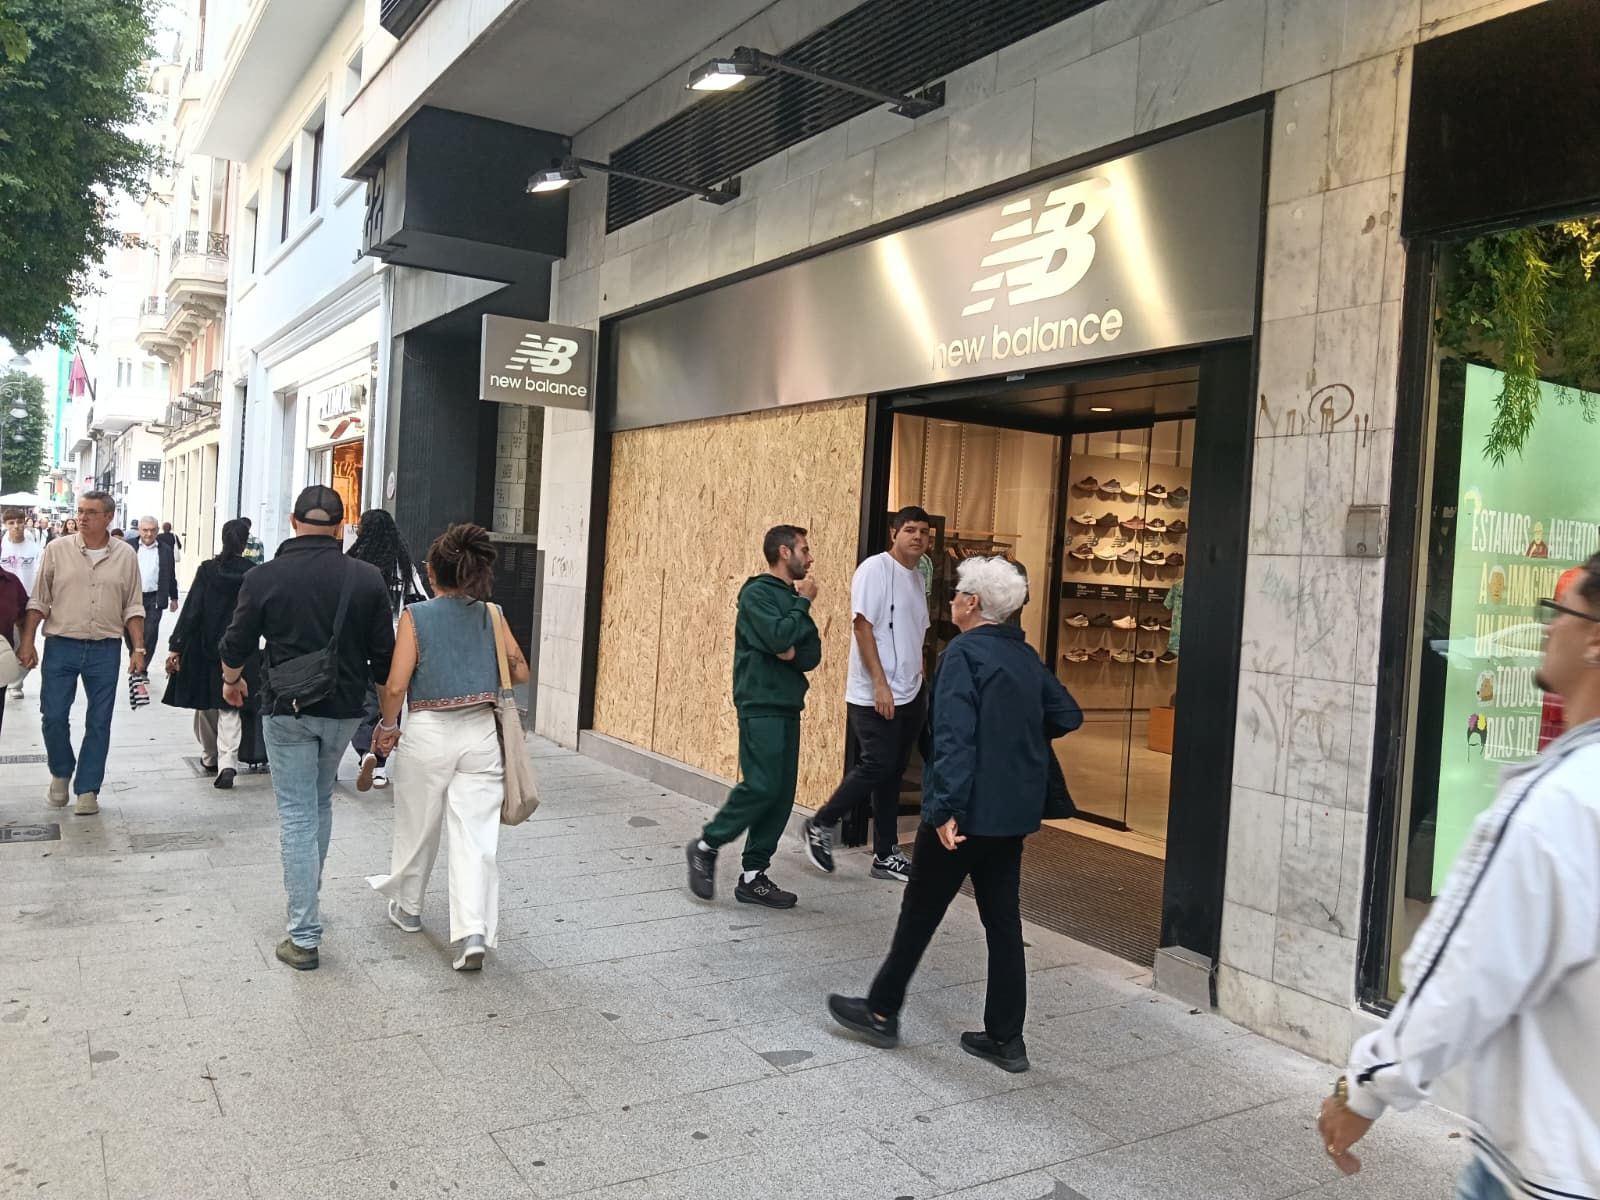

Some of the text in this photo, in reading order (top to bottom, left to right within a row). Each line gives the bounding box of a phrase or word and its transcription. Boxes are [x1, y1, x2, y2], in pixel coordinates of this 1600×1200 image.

[930, 308, 1124, 371] new balance
[490, 375, 588, 397] new balance
[1472, 508, 1531, 557] ESTAMOS
[1479, 562, 1488, 606] A
[1475, 614, 1494, 657] UN
[1495, 665, 1536, 708] TODOS
[1484, 717, 1515, 760] DIAS
